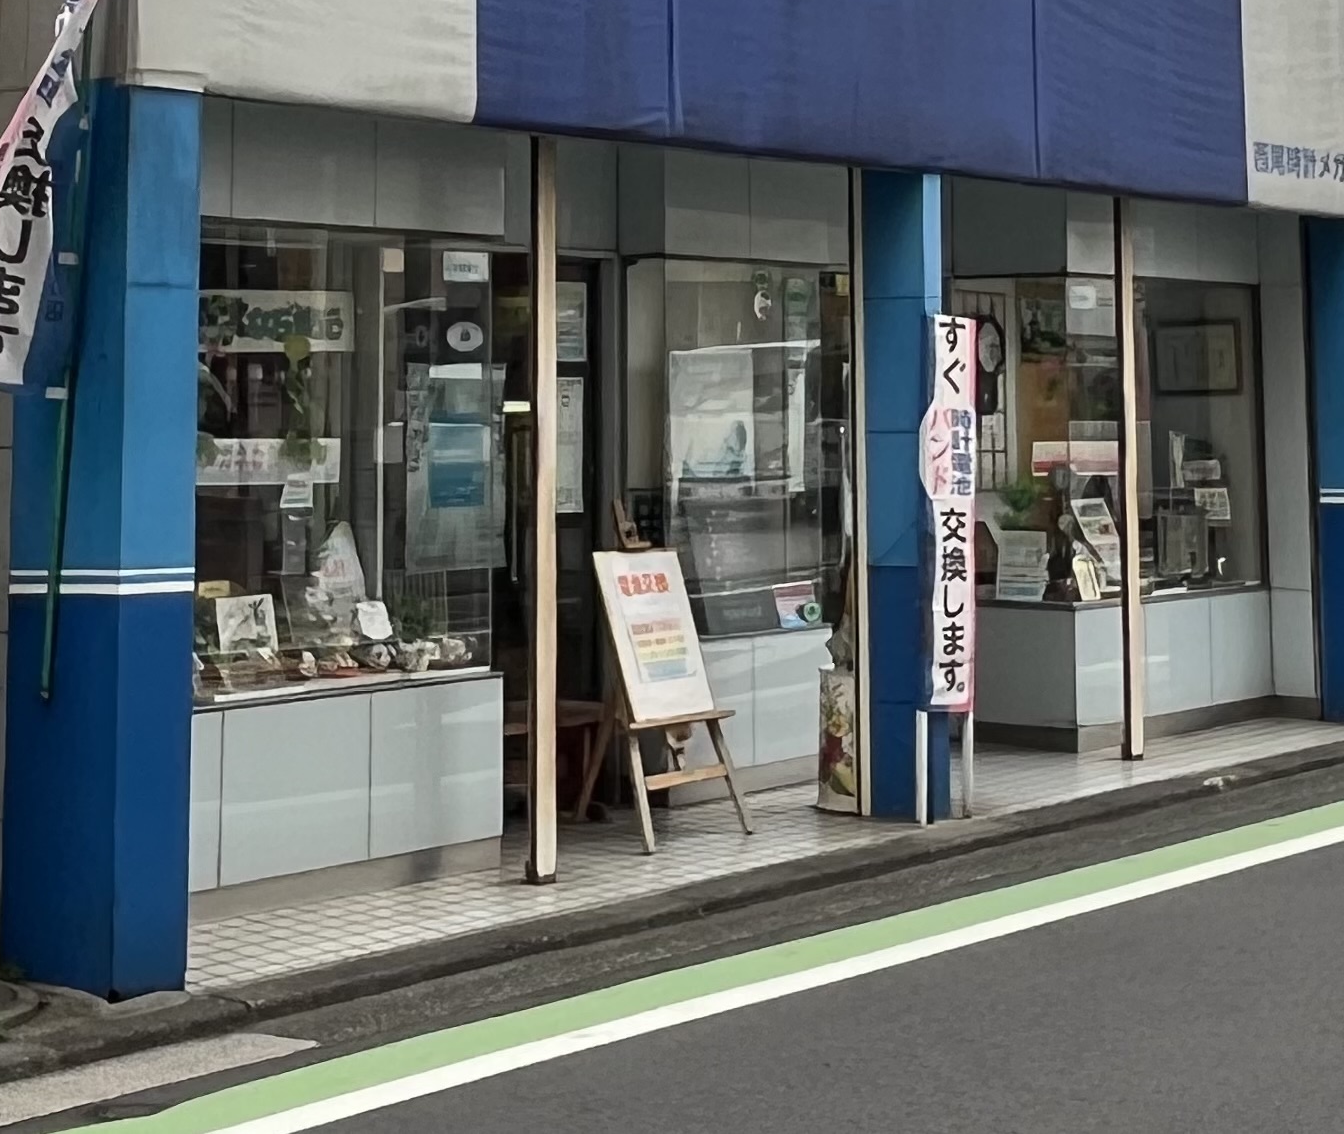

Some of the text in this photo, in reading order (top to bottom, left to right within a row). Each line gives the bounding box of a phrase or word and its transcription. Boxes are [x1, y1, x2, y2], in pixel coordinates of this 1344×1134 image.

[938, 317, 967, 395] すぐ
[938, 507, 968, 693] 交換します。
